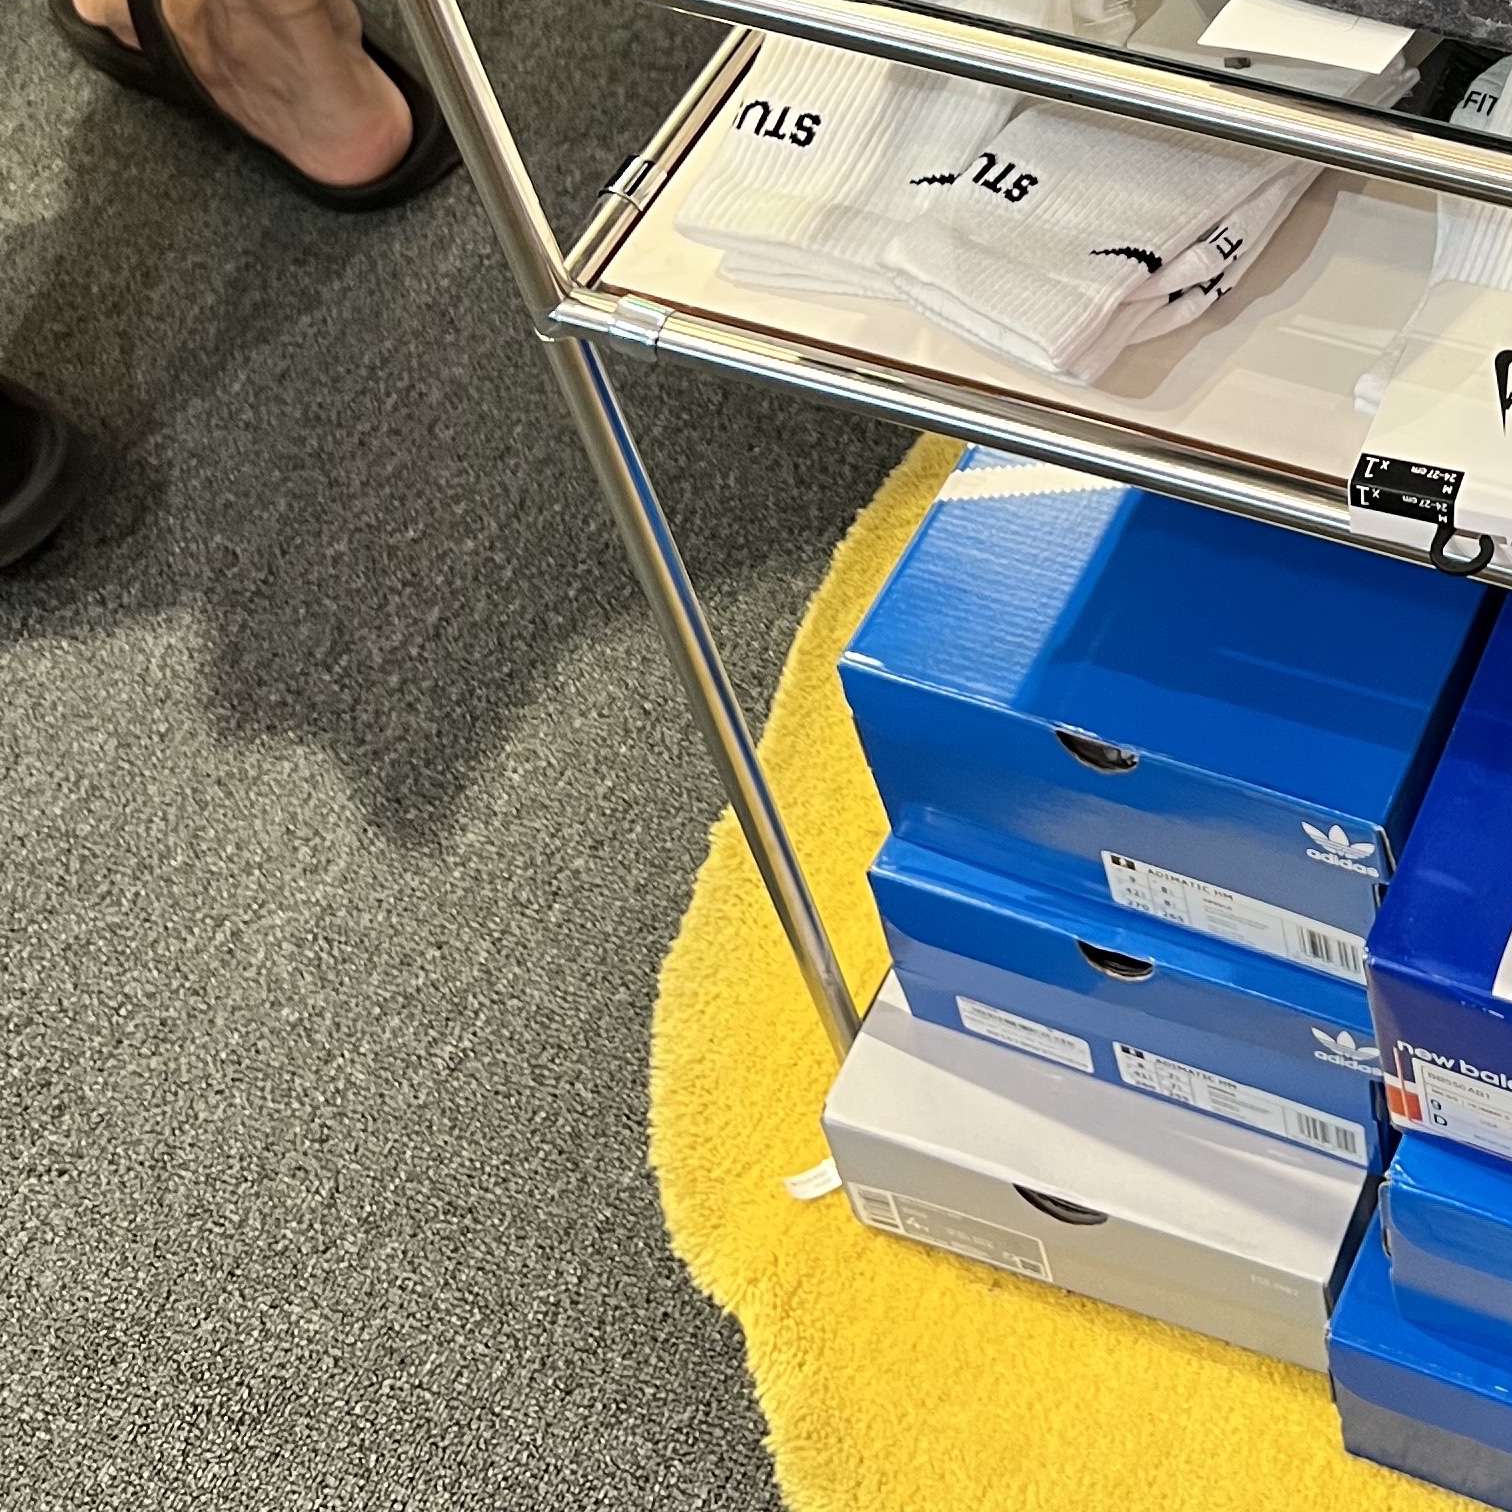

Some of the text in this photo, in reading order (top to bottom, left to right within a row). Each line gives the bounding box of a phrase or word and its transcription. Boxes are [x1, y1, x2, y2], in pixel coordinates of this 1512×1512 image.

[1306, 848, 1379, 878] adidas
[1147, 867, 1210, 896] ADIMATIC
[1314, 1050, 1383, 1077] adidas
[1396, 1039, 1456, 1069] new
[1433, 1113, 1448, 1127] D
